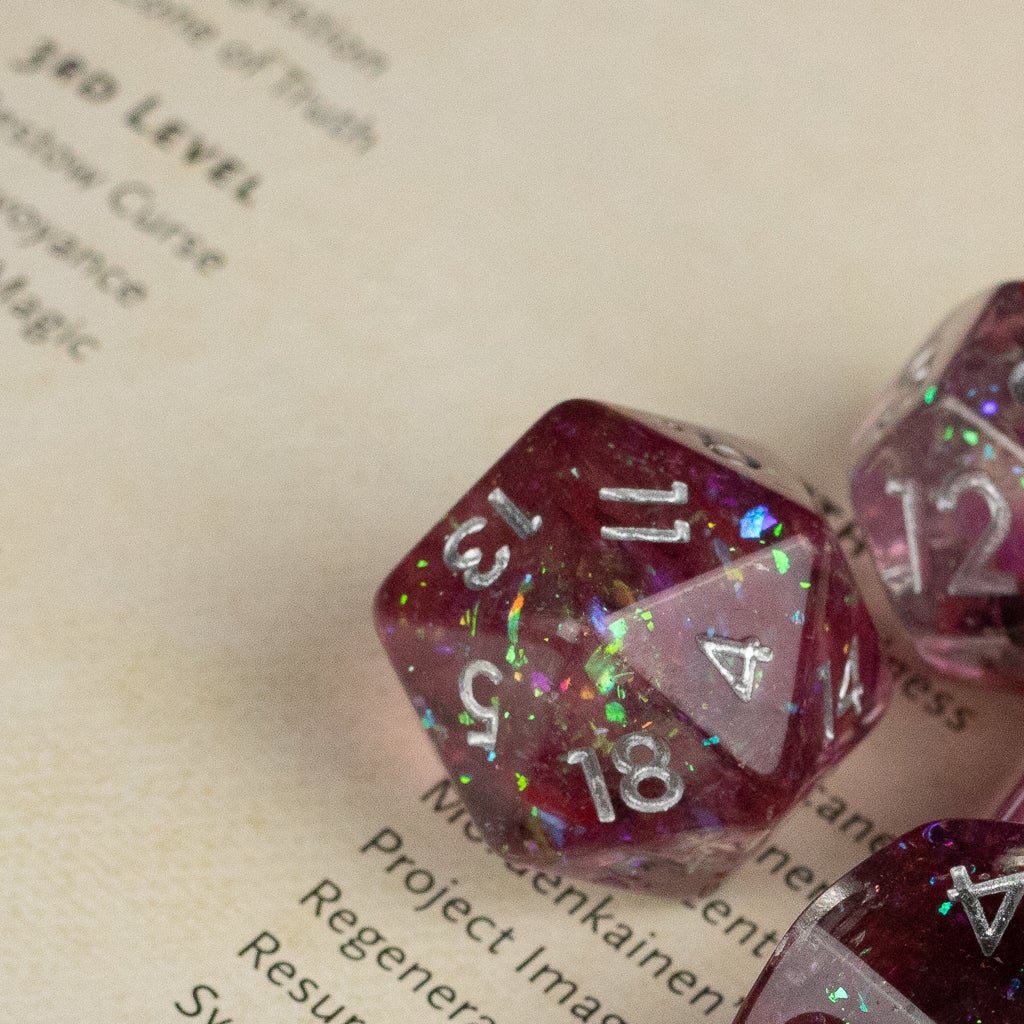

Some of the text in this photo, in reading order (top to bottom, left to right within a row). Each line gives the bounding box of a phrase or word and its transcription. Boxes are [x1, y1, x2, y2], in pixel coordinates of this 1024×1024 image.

[107, 180, 226, 276] Curse
[443, 487, 544, 590] 13
[598, 480, 691, 544] 11
[884, 474, 1018, 594] 12
[457, 658, 503, 753] 5
[696, 632, 773, 703] 4
[566, 734, 685, 824] 18
[359, 827, 516, 956] Project
